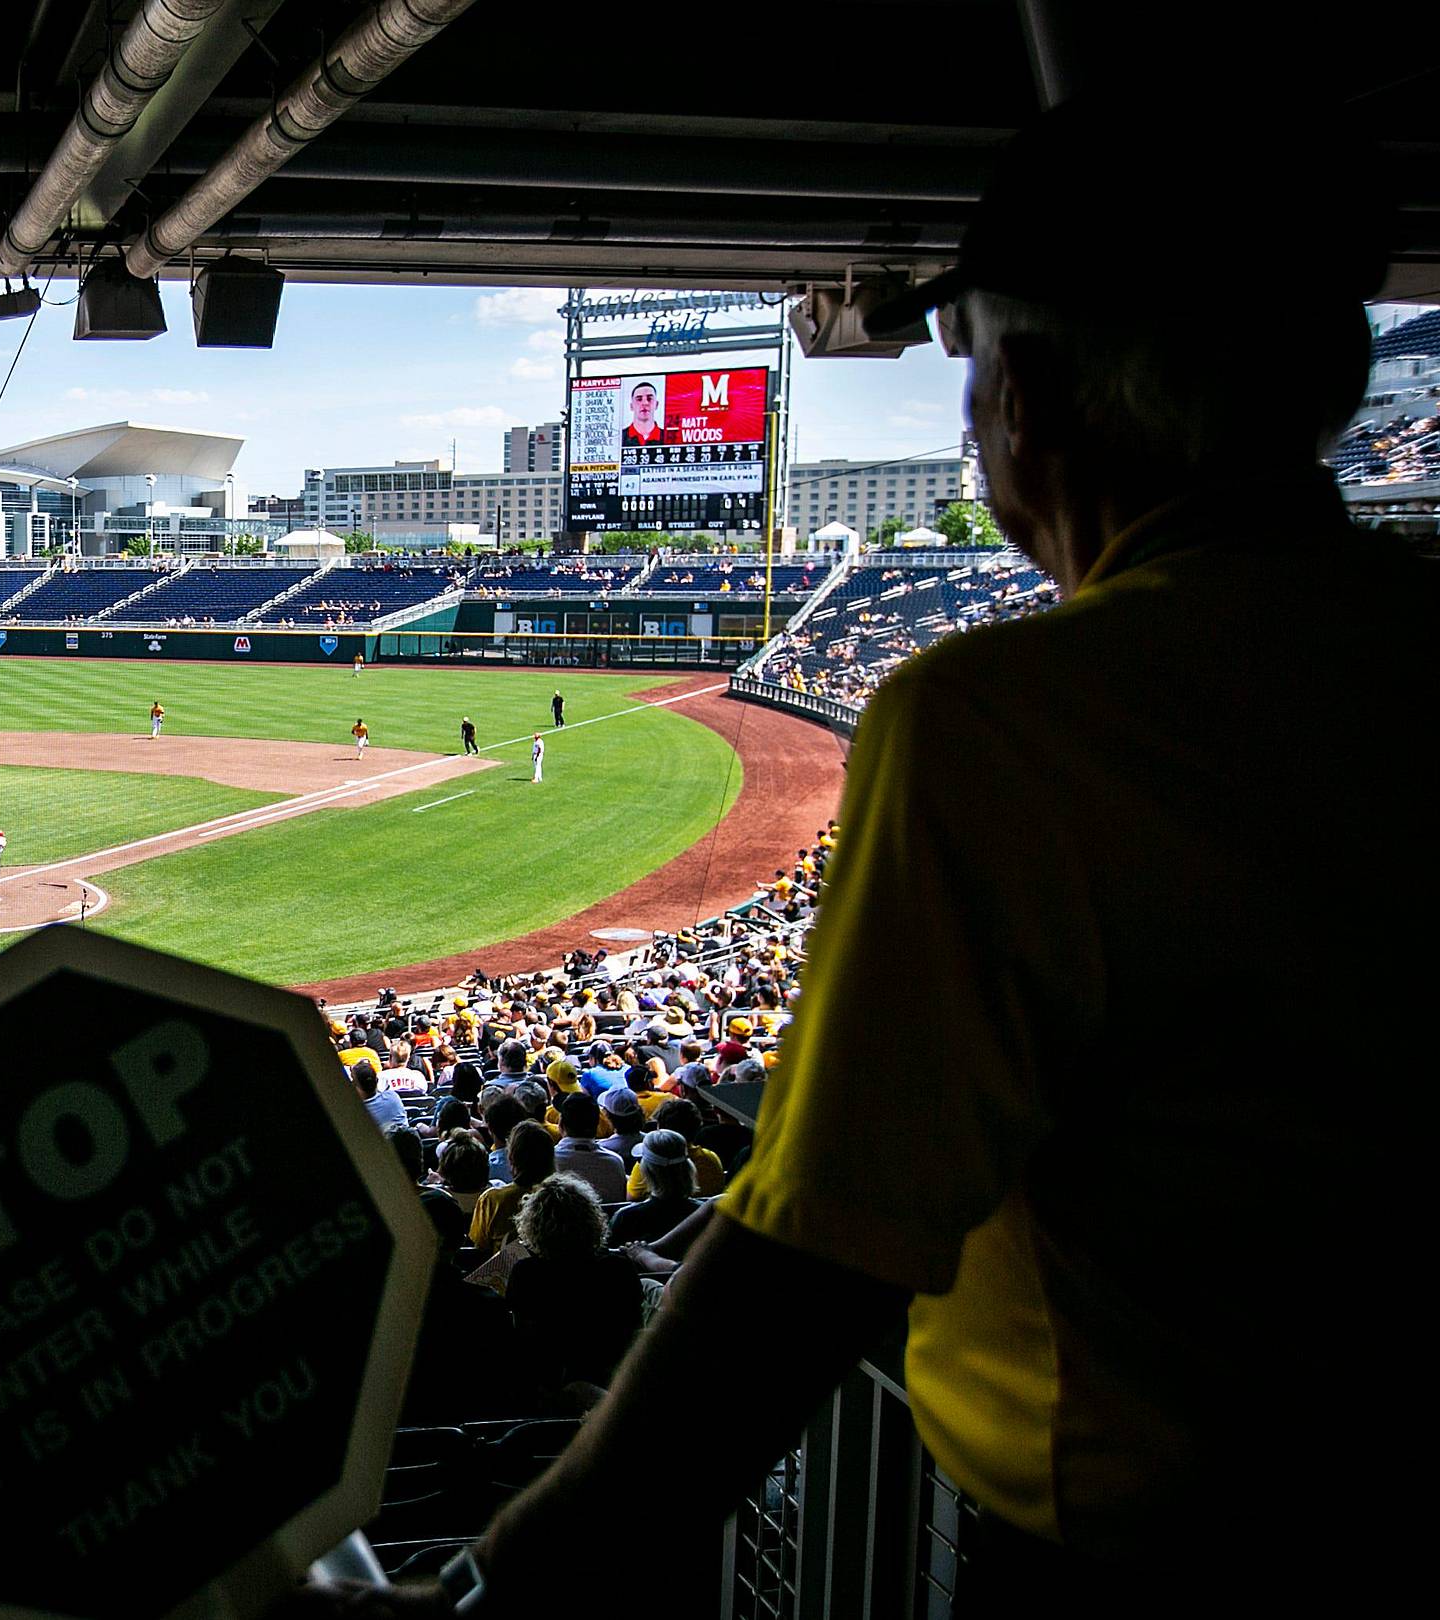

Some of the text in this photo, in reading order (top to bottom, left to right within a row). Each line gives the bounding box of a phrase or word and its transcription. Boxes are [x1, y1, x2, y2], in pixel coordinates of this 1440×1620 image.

[581, 378, 621, 387] MARYLAND
[700, 374, 730, 407] M
[682, 417, 708, 428] MATT
[682, 428, 723, 443] WOODS
[670, 454, 680, 462] 44
[700, 452, 711, 463] 20
[719, 452, 725, 461] 7
[622, 501, 628, 511] 0
[630, 501, 637, 511] 0
[639, 501, 645, 511] 0
[648, 501, 654, 511] 0
[724, 498, 731, 509] 0
[655, 521, 662, 530] 0
[84, 1207, 156, 1274] DO
[163, 1137, 255, 1221] NOT
[118, 1204, 265, 1316] WHILE
[19, 1409, 72, 1462] IS
[79, 1367, 134, 1423] IN
[138, 1199, 373, 1382] PROGRESS
[56, 1355, 318, 1557] THANK YOU
